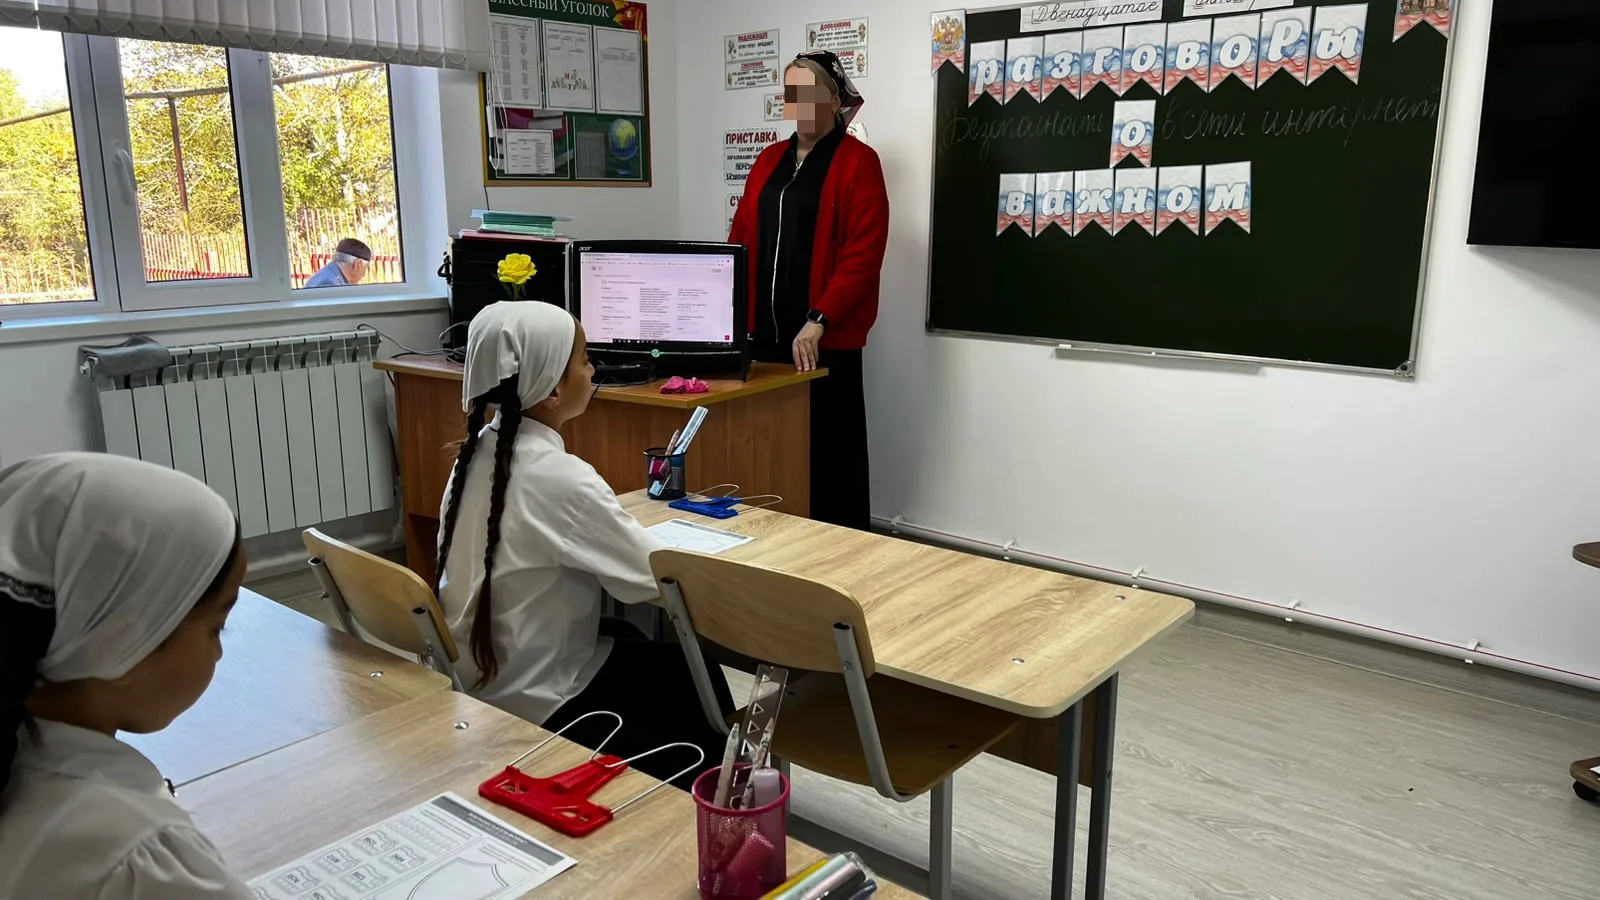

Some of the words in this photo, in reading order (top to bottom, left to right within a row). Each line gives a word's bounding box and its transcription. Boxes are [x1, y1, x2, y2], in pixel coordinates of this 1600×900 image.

[561, 0, 610, 18] УГОЛОК
[1033, 1, 1159, 27] Двенадцатое
[725, 131, 778, 145] ПРИСТАВКА
